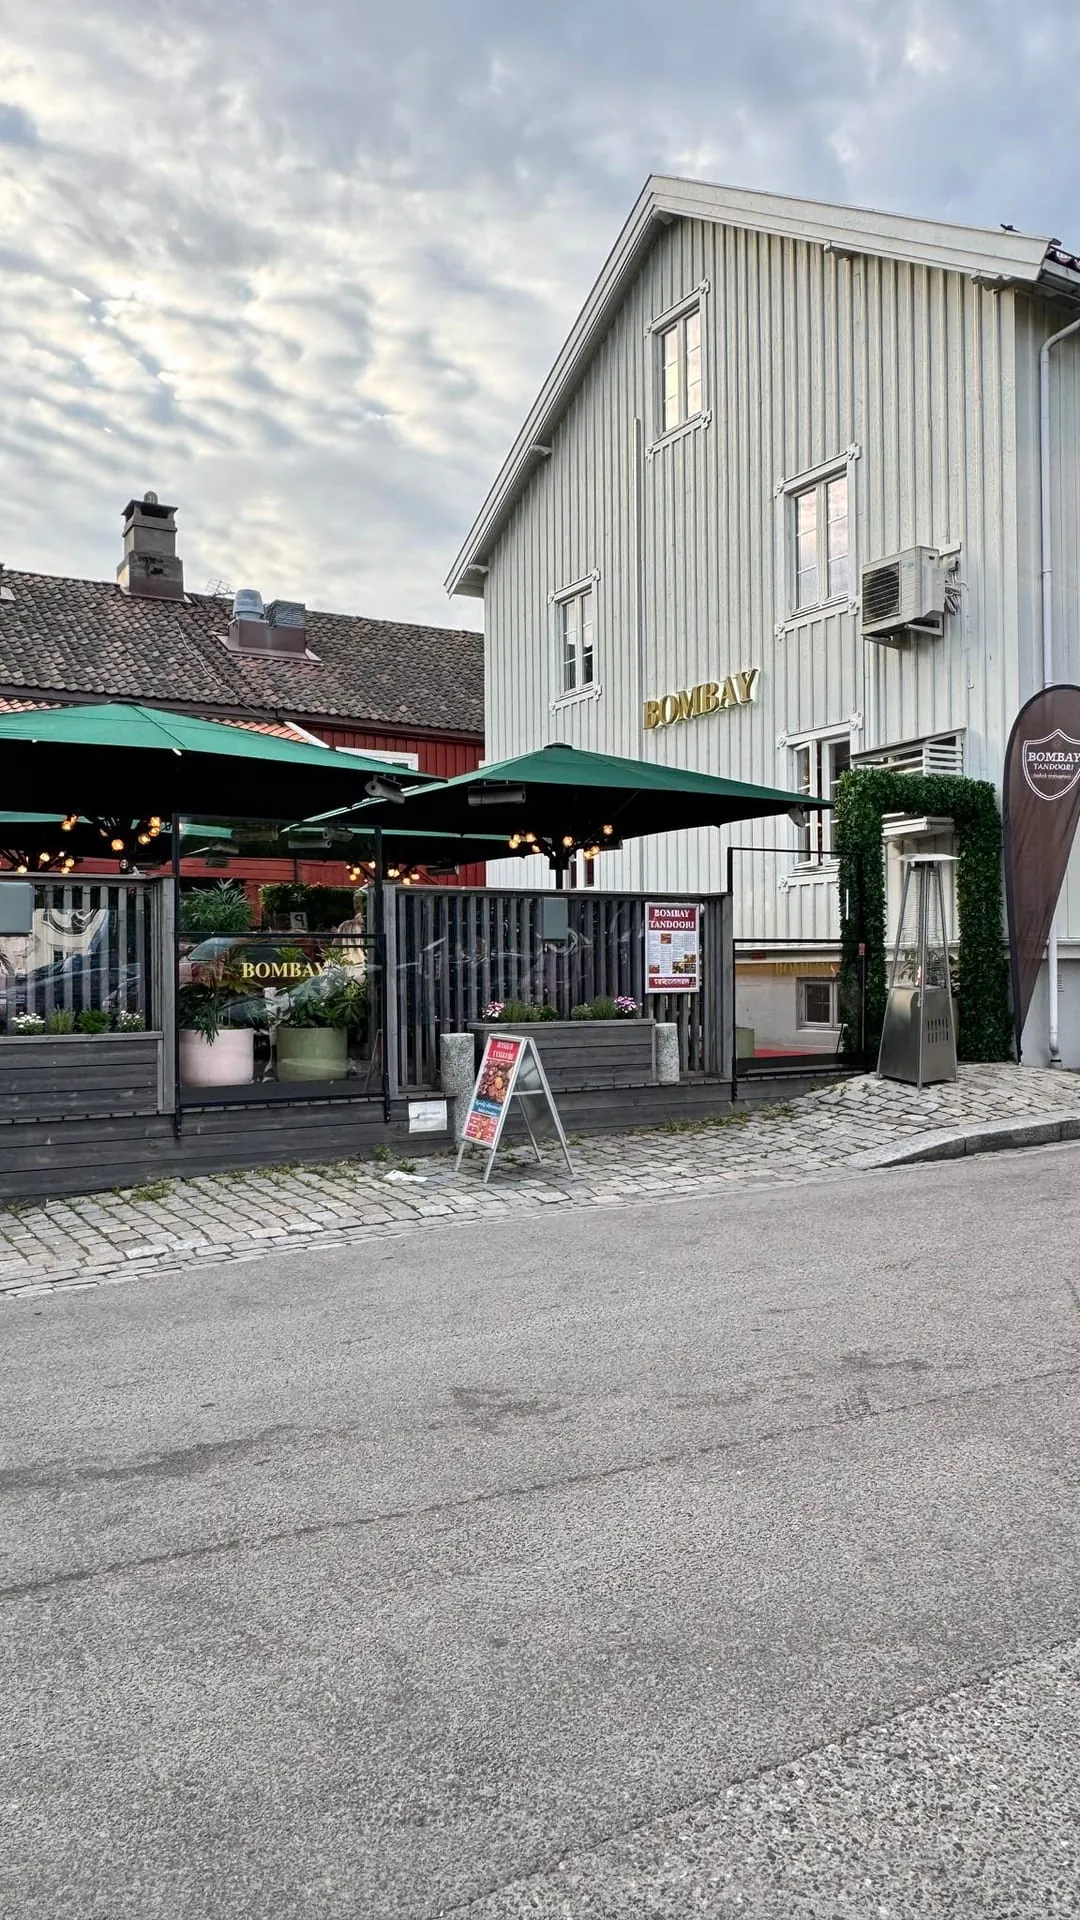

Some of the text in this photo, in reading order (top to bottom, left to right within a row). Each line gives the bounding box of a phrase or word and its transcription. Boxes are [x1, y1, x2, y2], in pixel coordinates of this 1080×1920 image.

[643, 668, 759, 729] BOMBAY
[1027, 752, 1080, 762] BOMBAY
[1033, 763, 1074, 771] TANDOORI
[654, 909, 690, 918] BOMBAY
[650, 920, 695, 929] TANDOORI
[242, 962, 324, 978] BOMBAY
